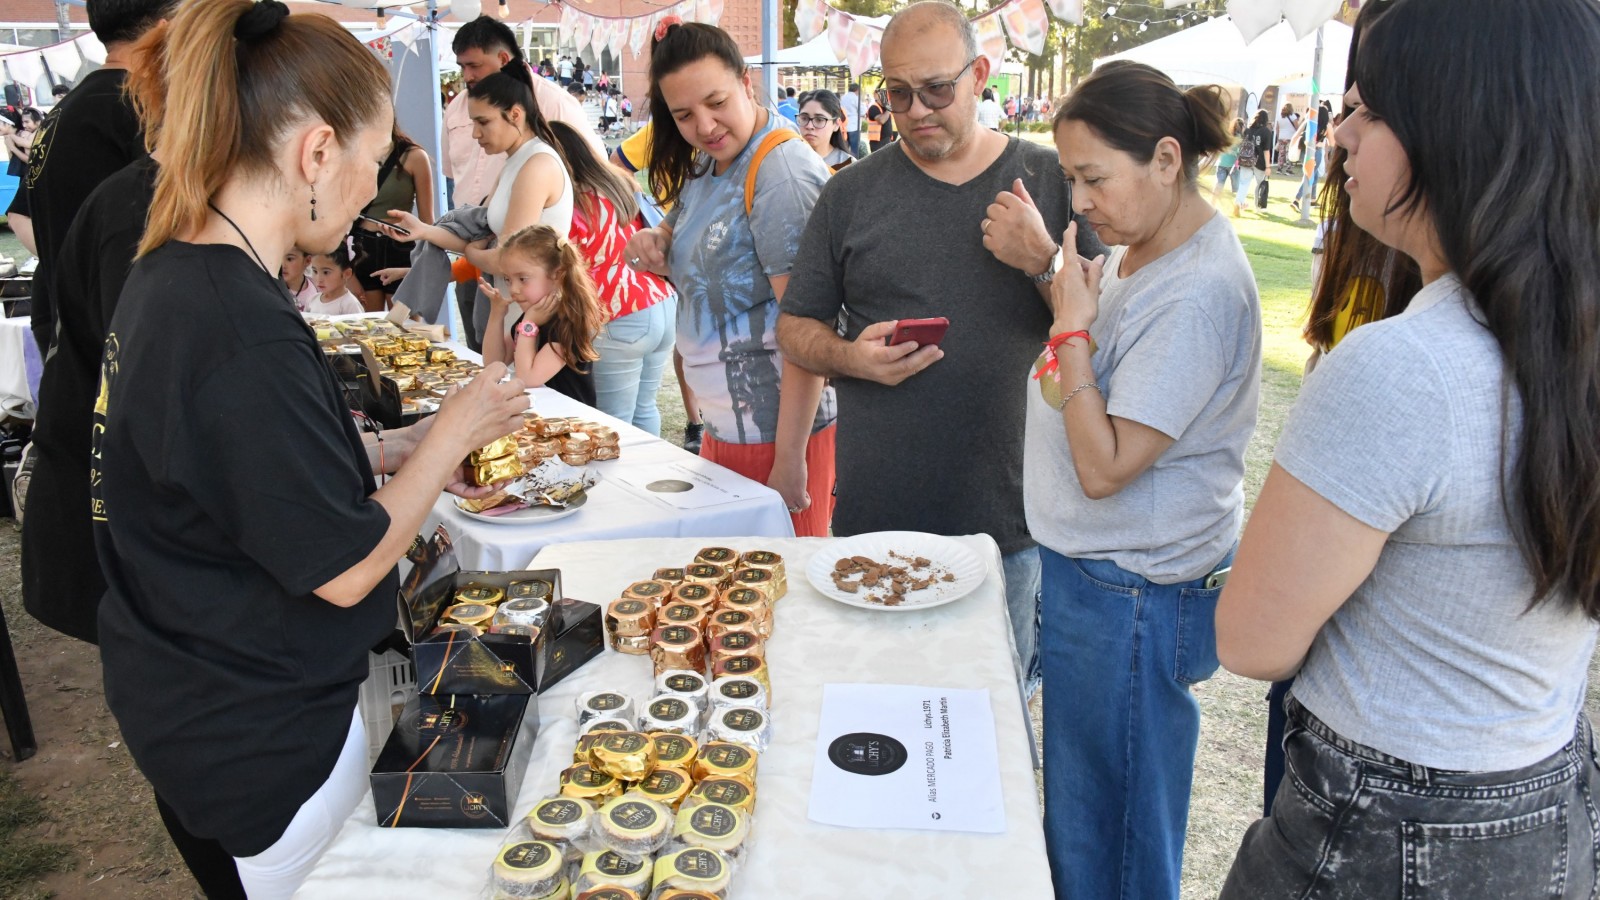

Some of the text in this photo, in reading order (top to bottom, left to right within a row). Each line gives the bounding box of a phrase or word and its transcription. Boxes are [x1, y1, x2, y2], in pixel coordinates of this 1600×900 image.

[941, 714, 951, 738] Elizabeth
[868, 740, 880, 768] LICHY'S
[922, 700, 937, 803] Alias MERCADO PAGO Lichys.1971
[943, 738, 952, 760] Patricia
[622, 807, 651, 827] LICHY'S
[698, 851, 708, 876] LICHY'S
